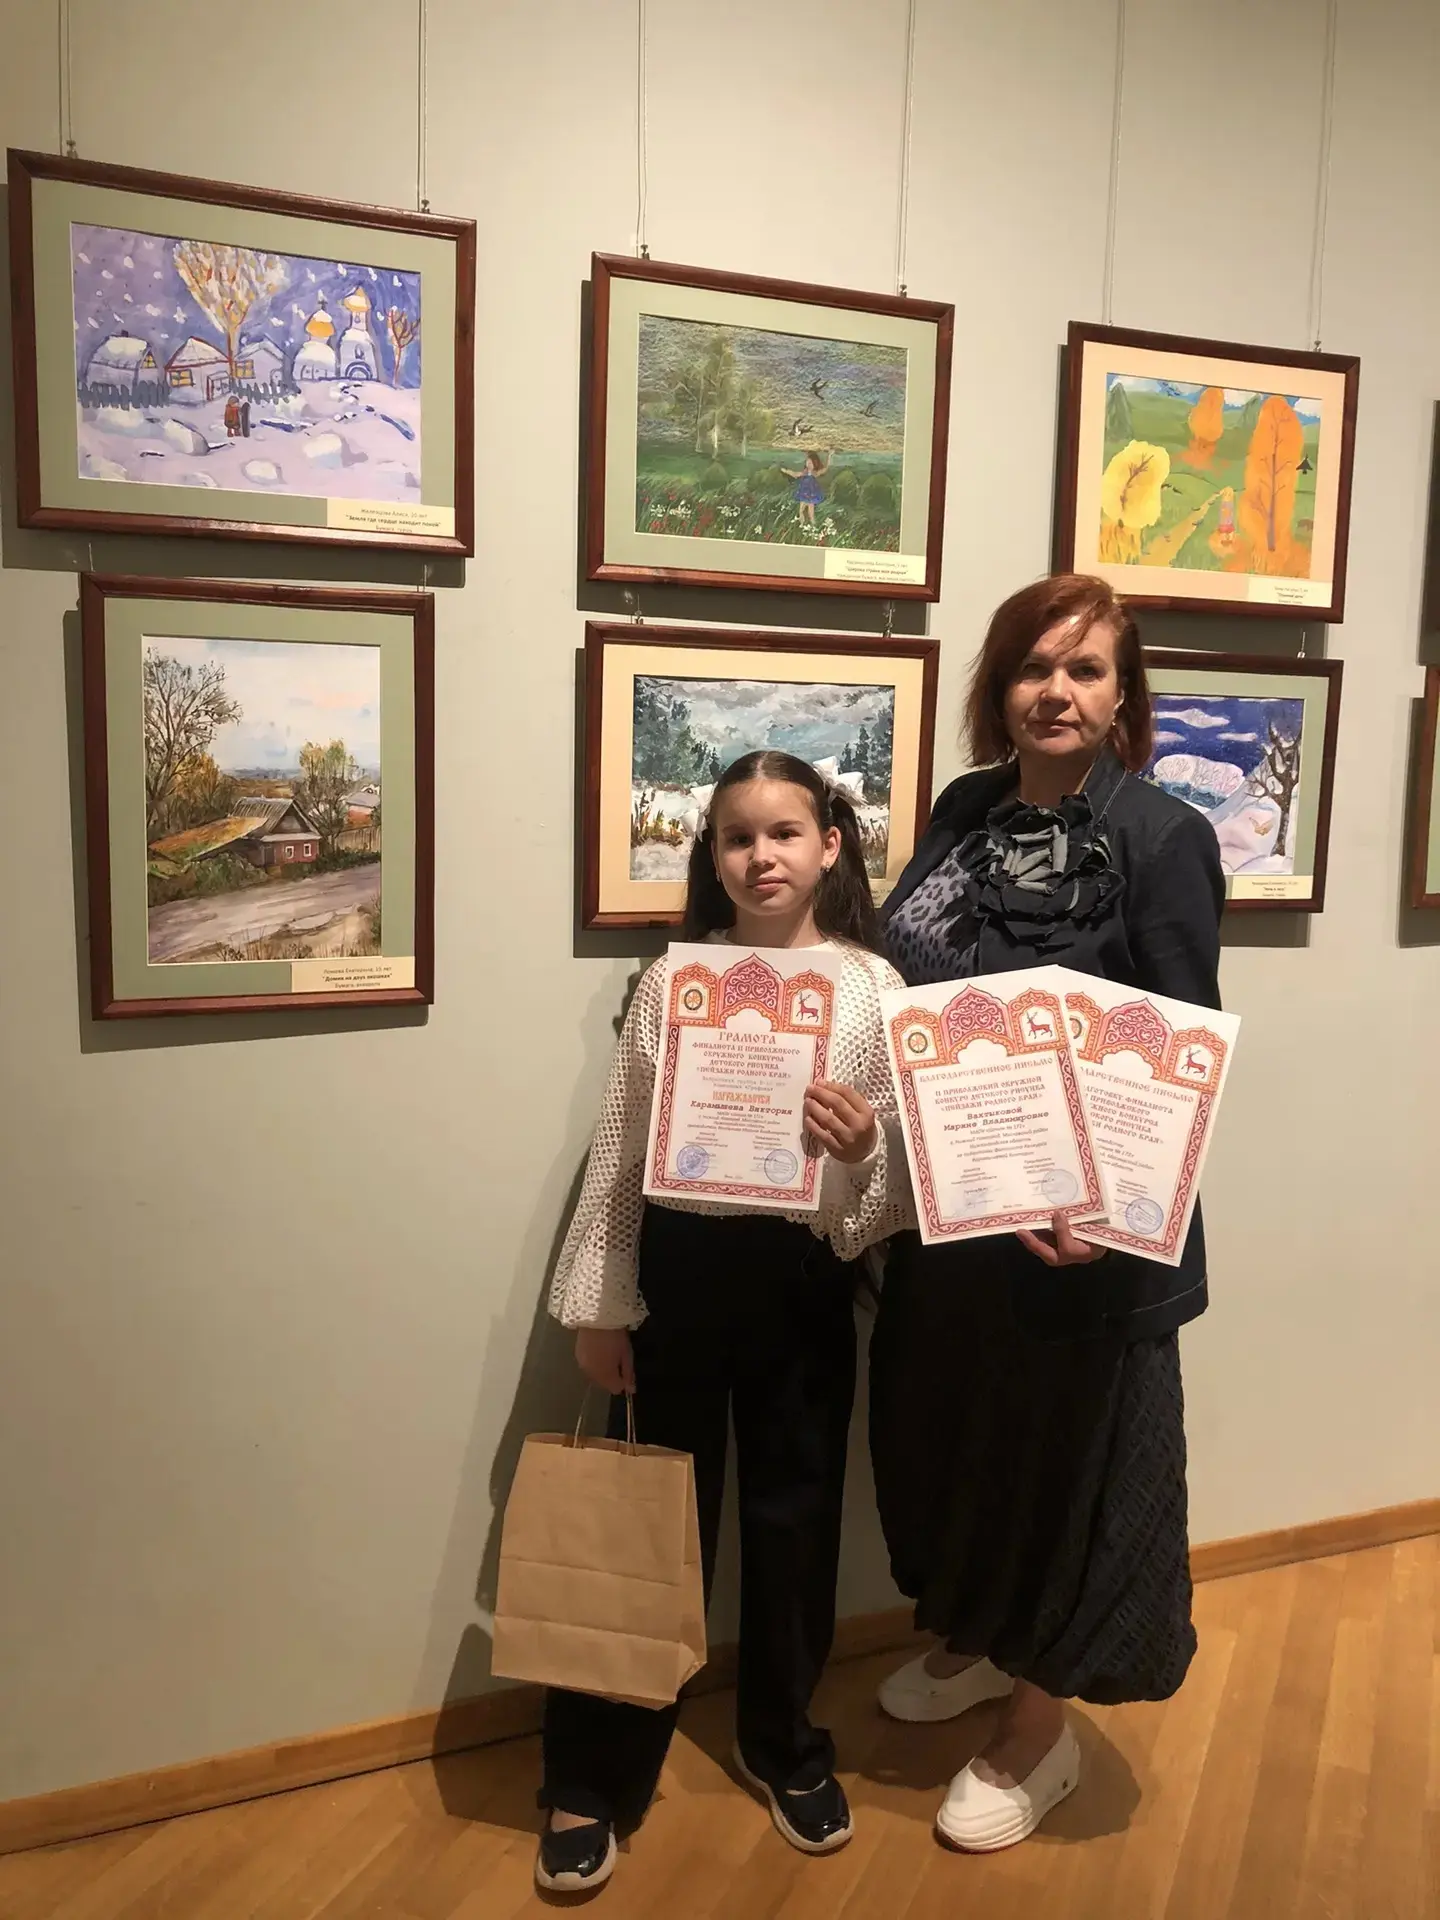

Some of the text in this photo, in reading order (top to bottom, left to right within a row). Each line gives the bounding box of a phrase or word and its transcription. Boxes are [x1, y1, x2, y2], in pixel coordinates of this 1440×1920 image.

[719, 1032, 776, 1044] ГРАМОТА
[692, 1042, 735, 1051] ФИНАЛИСТА
[745, 1046, 800, 1055] ПРИВОЛЖСКОГО
[703, 1051, 784, 1062] ОКРУЖНОГО КОНКУРСА
[709, 1059, 779, 1070] ДЕТСКОГО РИСУНКА
[920, 1057, 1053, 1082] БЛАГОДАРСТВЕННОЕ ПИСЬМО
[737, 1069, 767, 1077] РОДНОГО
[943, 1082, 999, 1095] ПРИВОЛЖСКИЙ
[1001, 1076, 1042, 1087] ОКРУЖНОЙ
[1080, 1066, 1194, 1103] ДАРСТВЕННОЕ ПИСЬМО
[713, 1090, 771, 1105] НАГРАЖДАЕТСЯ
[935, 1084, 1045, 1105] КОНКУРС ДЕТСКОГО РИСУНКА
[690, 1101, 744, 1111] Карамышева
[749, 1105, 793, 1115] Виктория
[941, 1101, 982, 1112] «ПЕЙЗАЖИ
[984, 1096, 1016, 1106] РОДНОГО
[1090, 1095, 1151, 1116] ПРИВОЛЖСКОГО
[1125, 1096, 1174, 1115] ФИНАЛИСТА
[967, 1106, 1022, 1120] Вахтыковой
[1119, 1111, 1159, 1127] КОНКУРСА
[944, 1111, 1049, 1132] Марине Владимировне
[1115, 1119, 1152, 1134] РИСУНКА
[1103, 1124, 1137, 1138] РОДНОГО
